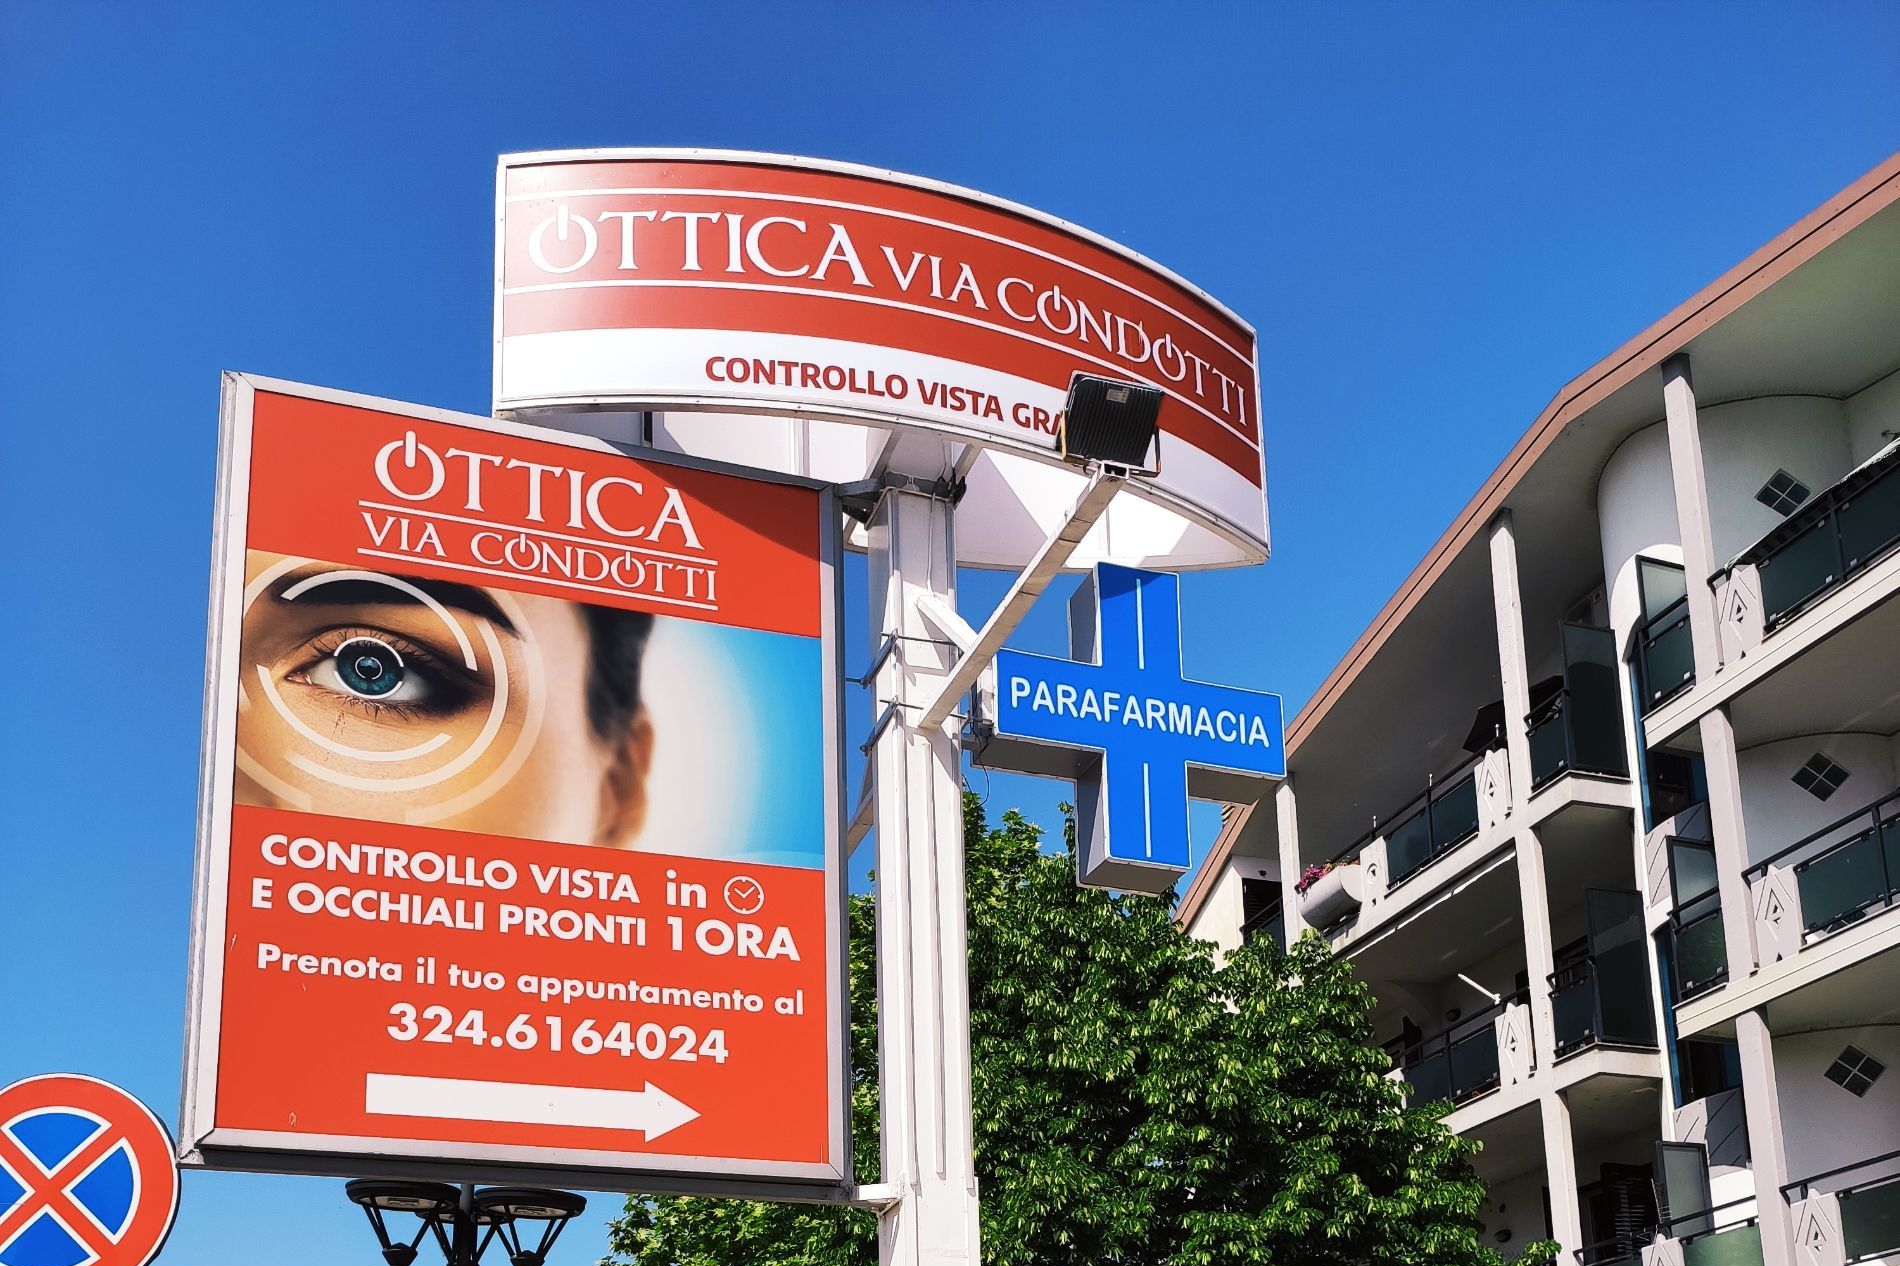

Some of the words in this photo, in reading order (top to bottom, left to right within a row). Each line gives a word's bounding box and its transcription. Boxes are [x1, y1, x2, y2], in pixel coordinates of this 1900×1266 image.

[528, 203, 874, 287] OTTICA
[880, 244, 989, 311] VIA
[997, 276, 1248, 426] CONDOTTI
[705, 356, 908, 399] CONTROLLO
[917, 380, 1004, 421] VISTA
[374, 430, 705, 550] OTTICA
[361, 511, 448, 557] VIA
[470, 532, 718, 601] CONDOTTI
[1010, 676, 1270, 748] PARAFARMACIA
[260, 833, 518, 891] CONTROLLO
[529, 863, 641, 904] VISTA
[665, 868, 708, 909] in
[251, 877, 275, 910] E
[287, 882, 485, 932] OCCHIALI
[498, 902, 647, 947] PRONTI
[256, 943, 403, 983] Prenota
[415, 956, 436, 985] il
[447, 964, 506, 992] tuo
[516, 974, 765, 1016] appuntamento
[773, 989, 805, 1016] al
[386, 1003, 730, 1065] 324.6164024
